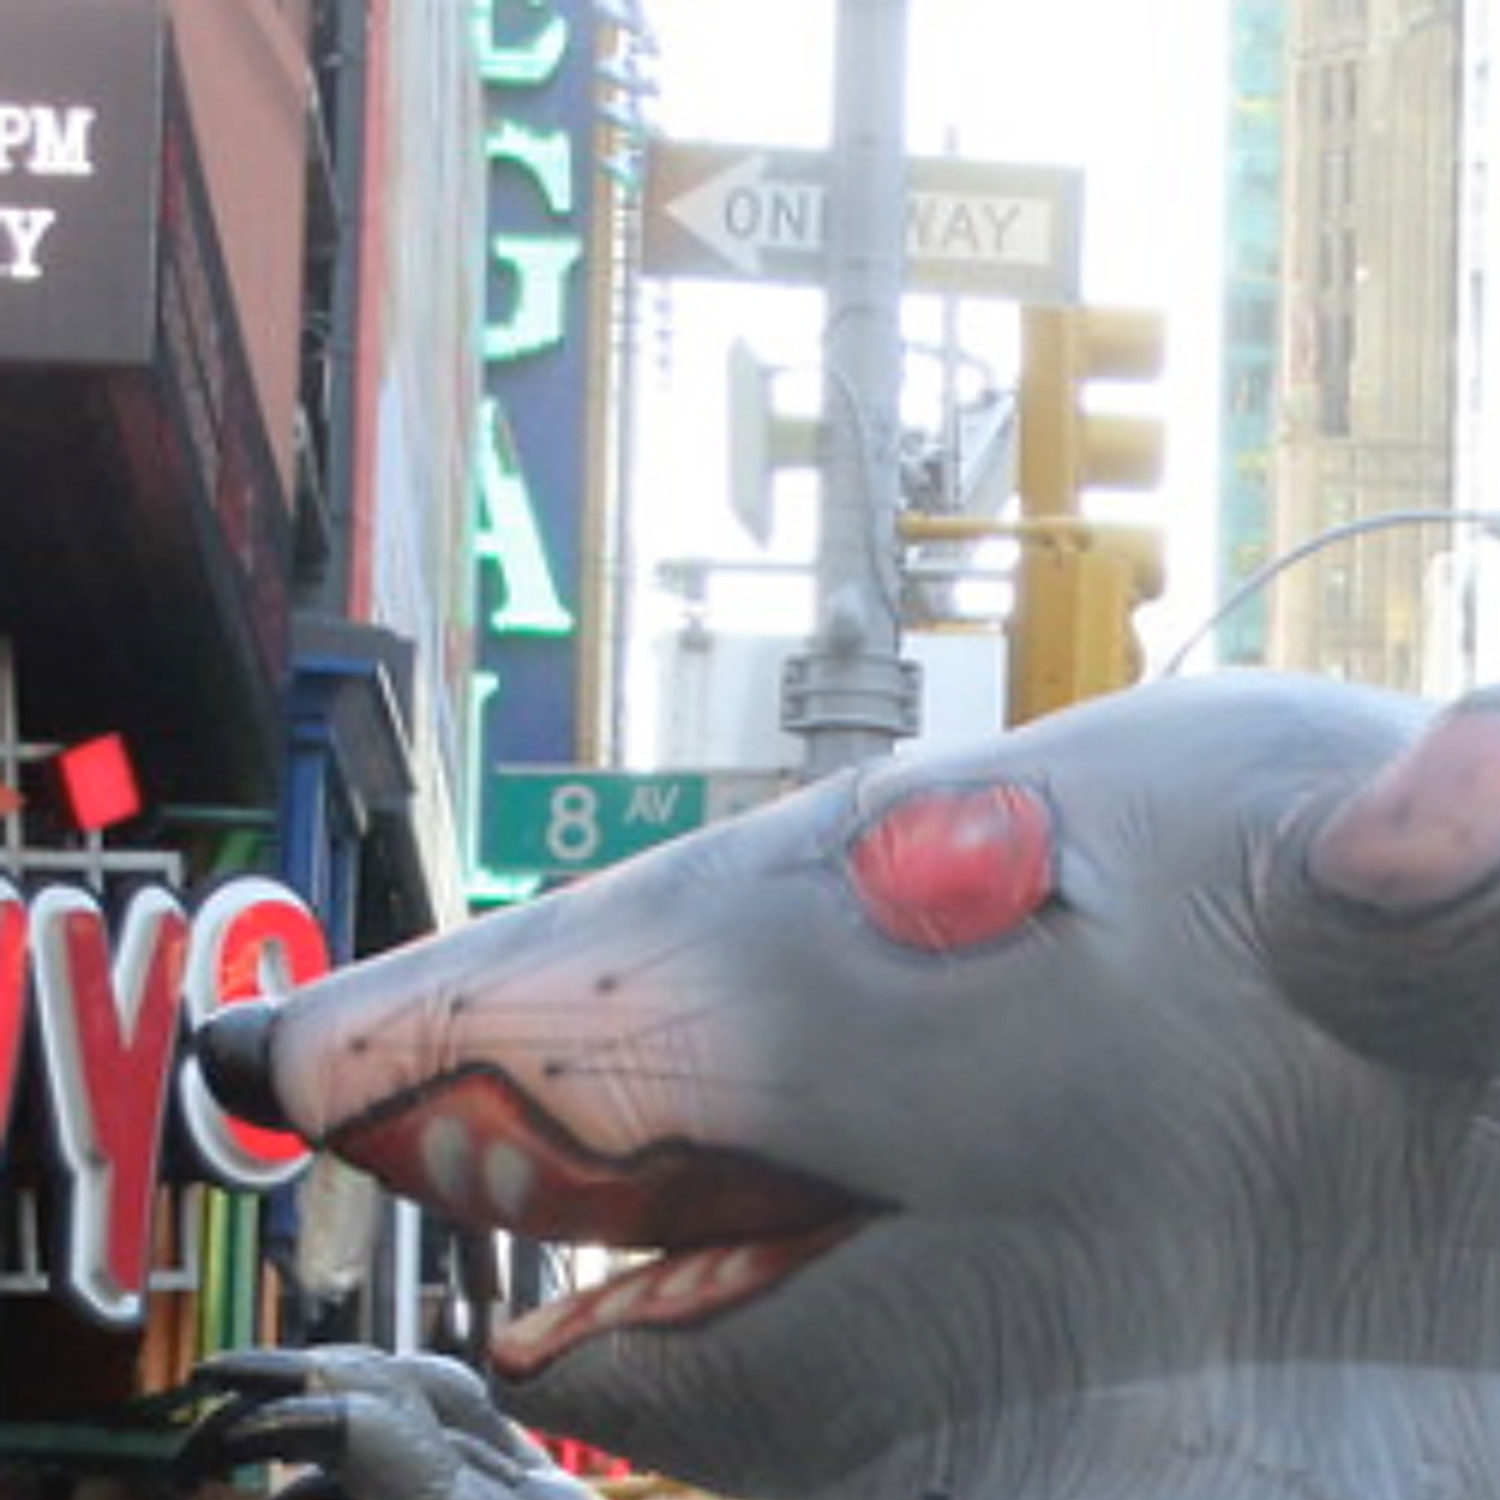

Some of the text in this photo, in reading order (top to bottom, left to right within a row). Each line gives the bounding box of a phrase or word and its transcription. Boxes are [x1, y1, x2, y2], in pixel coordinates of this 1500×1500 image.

[723, 184, 829, 243] ON
[545, 783, 682, 862] 8 AV
